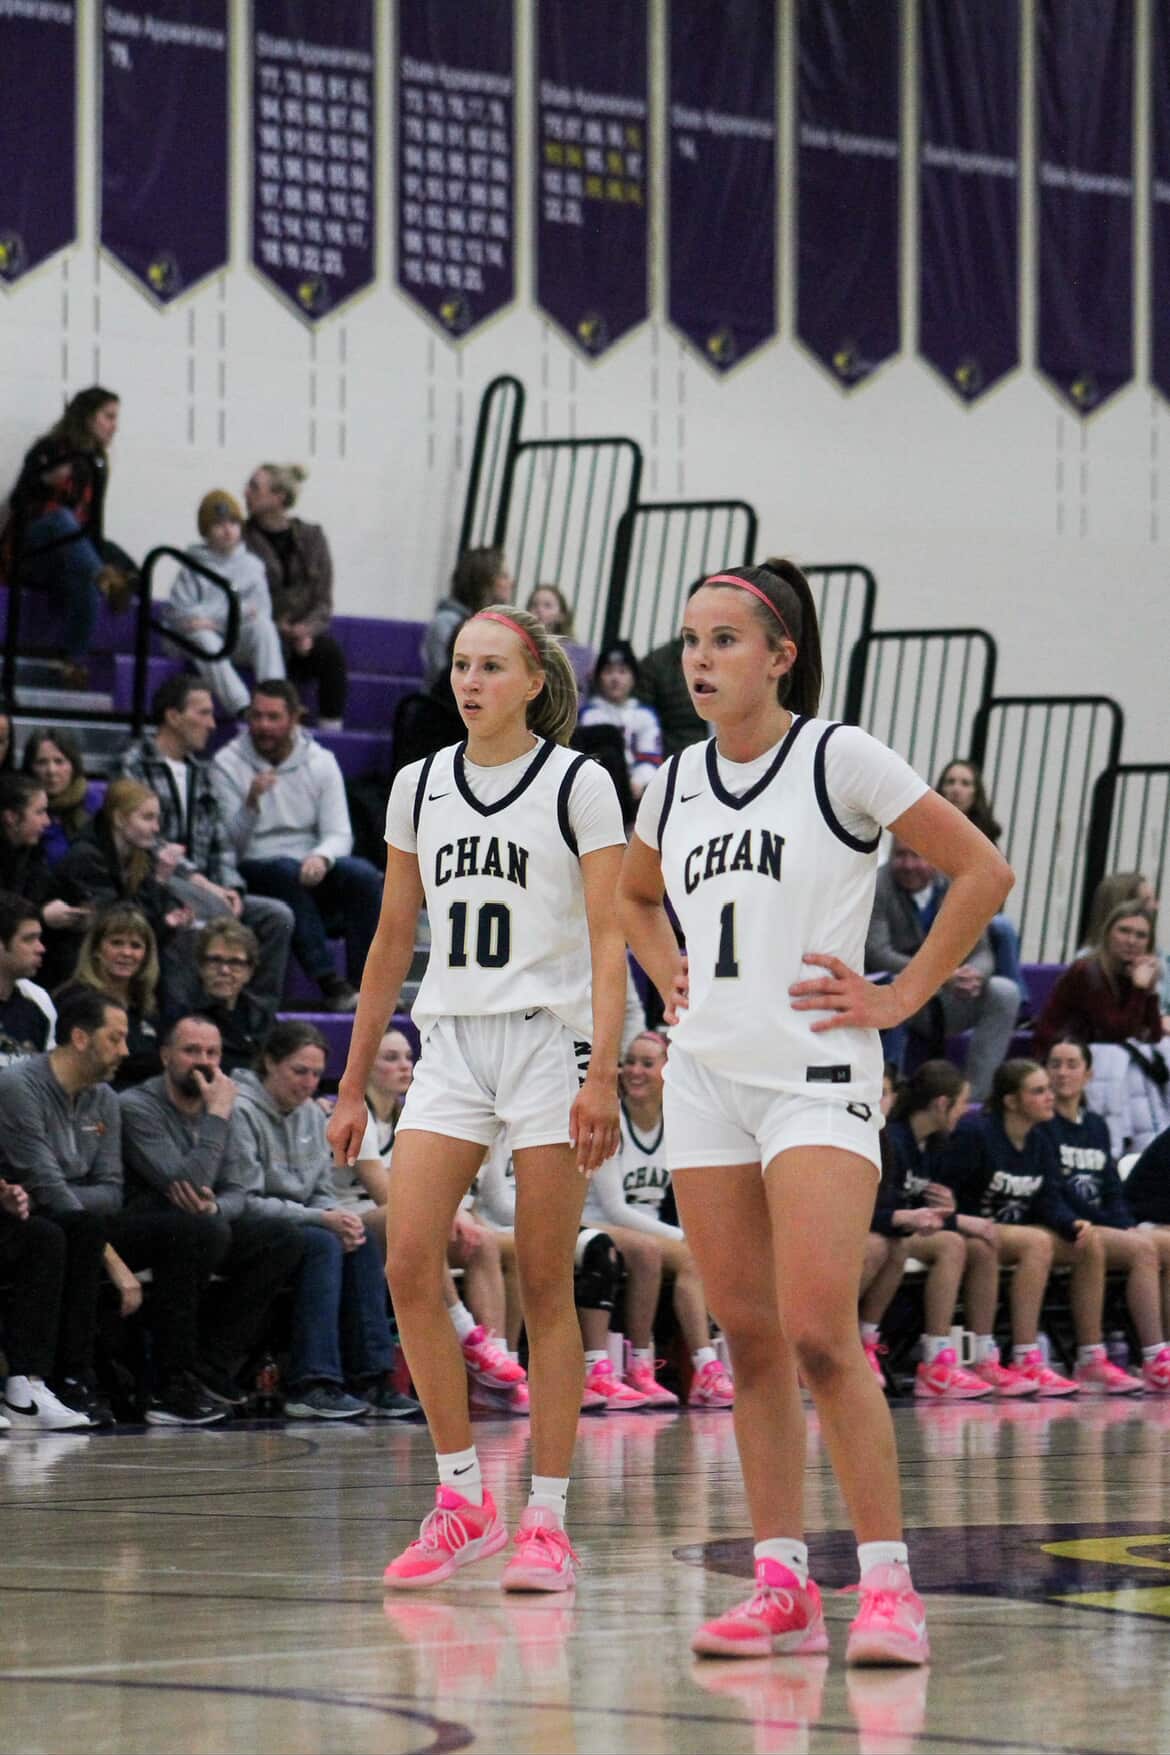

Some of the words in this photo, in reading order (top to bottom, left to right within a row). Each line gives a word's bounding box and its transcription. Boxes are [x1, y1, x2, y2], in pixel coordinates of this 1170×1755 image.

[435, 836, 529, 889] CHAN
[684, 829, 786, 895] CHAN
[447, 900, 512, 969] 10
[713, 901, 740, 979] 1
